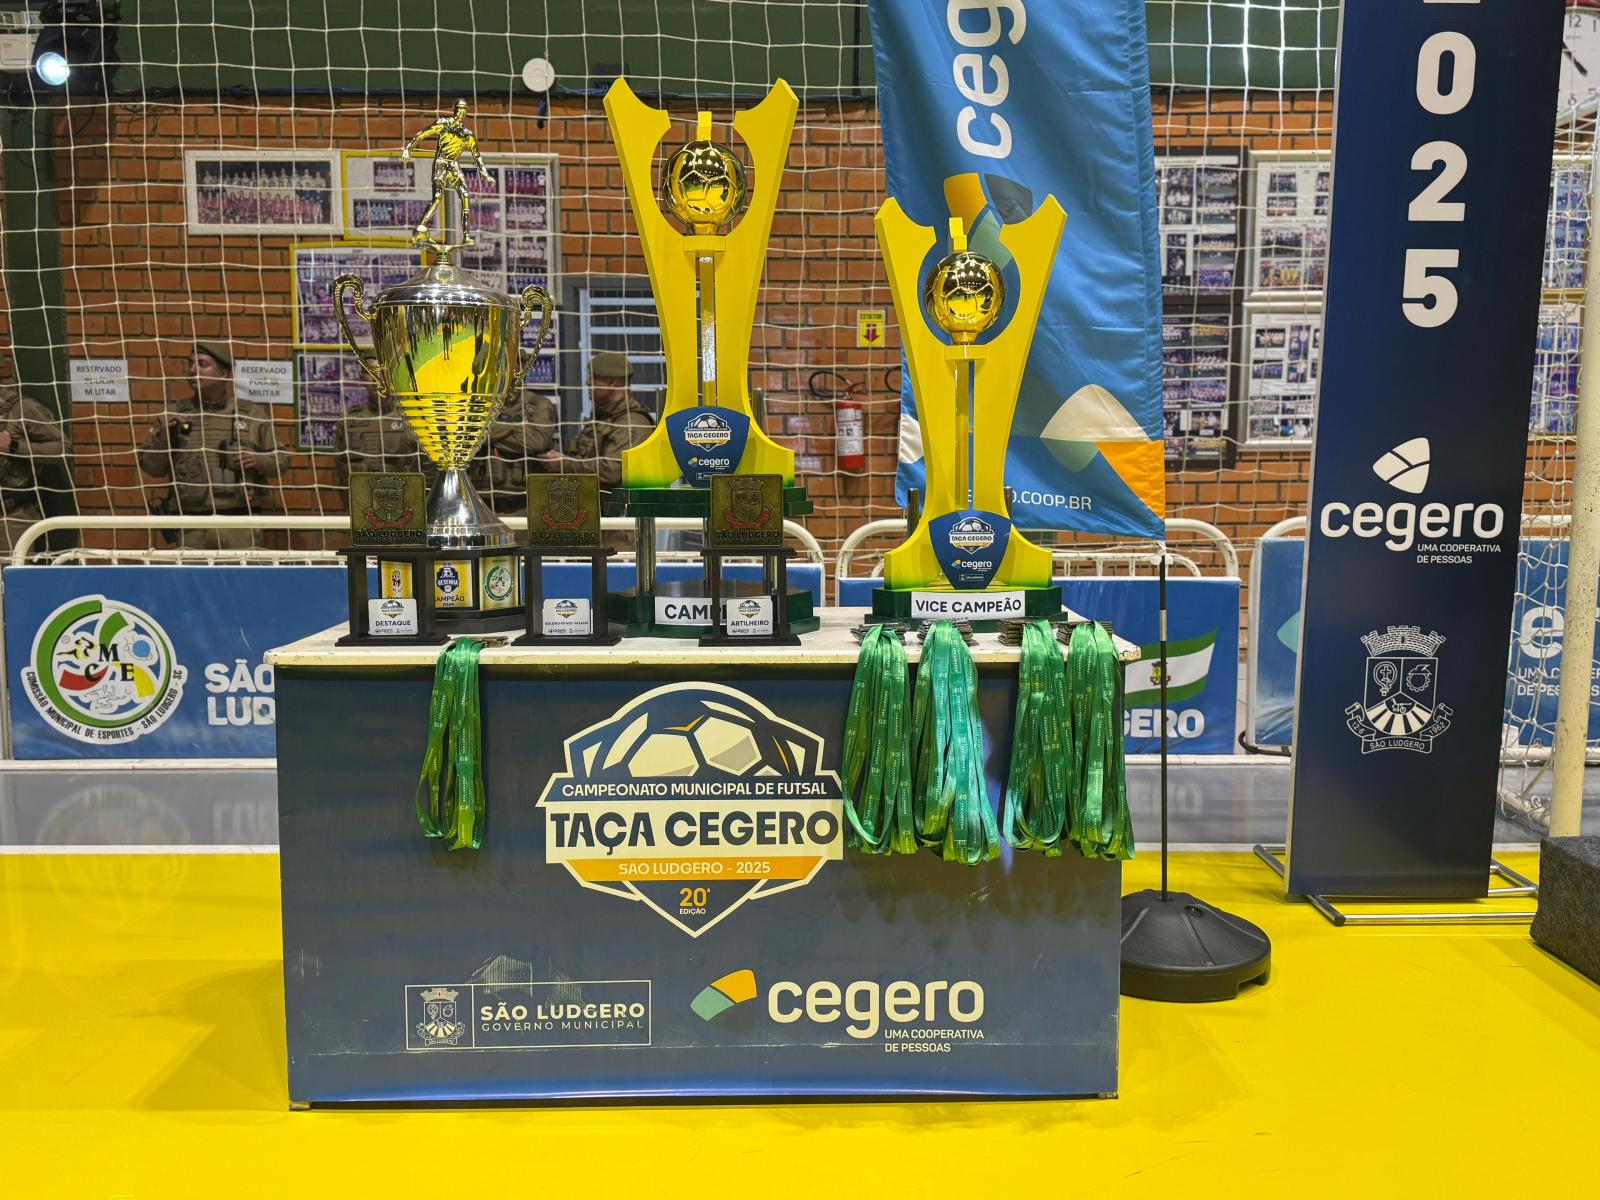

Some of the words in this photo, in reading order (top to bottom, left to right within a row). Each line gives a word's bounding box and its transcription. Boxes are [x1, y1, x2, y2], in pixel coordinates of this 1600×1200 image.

[1402, 0, 1482, 328] 025
[76, 365, 122, 374] RESERVADO
[241, 366, 287, 375] RESERVADO
[84, 388, 117, 397] MLITAR
[248, 389, 281, 398] MILITAR
[698, 458, 730, 468] cegero
[1320, 502, 1504, 552] cegero
[1417, 543, 1439, 552] UMA
[1439, 543, 1501, 553] COOPERATIVA
[961, 560, 992, 570] cegero
[1416, 555, 1429, 564] DE
[1430, 555, 1473, 564] PESSOAS
[435, 594, 465, 602] AMPEÃO
[915, 600, 948, 613] VICE
[951, 597, 1022, 613] CAMPEÃO
[98, 643, 119, 662] M
[204, 658, 275, 693] SÃO
[26, 671, 49, 708] COMISSÃO
[45, 707, 81, 735] MUNICIPAL
[84, 727, 95, 738] DE
[98, 726, 134, 740] ESPORTES
[141, 713, 157, 729] SÃO
[154, 688, 178, 718] LUDGERO
[173, 669, 182, 680] SC
[1428, 721, 1446, 736] 1962
[1369, 739, 1387, 750] SÃO
[1388, 738, 1426, 750] LUDGERO
[562, 783, 667, 797] CAMPEONATO
[671, 783, 753, 796] MUNICIPAL
[757, 783, 775, 795] DE
[777, 782, 827, 795] FUTSAL
[550, 812, 656, 856] TAÇA
[664, 810, 839, 847] CEGERO
[618, 861, 650, 875] SÃO
[653, 861, 724, 875] LUDGERO
[736, 861, 771, 874] 2025
[679, 907, 707, 916] EDIÇÃO
[480, 1002, 528, 1021] SÃO
[537, 1002, 645, 1020] LUDGERO
[768, 980, 985, 1039] cegero
[481, 1022, 554, 1032] GOVERNO
[561, 1020, 644, 1031] MUNICIPAL
[885, 1029, 909, 1039] UMA
[911, 1029, 984, 1039] COOPERATIVA
[885, 1043, 899, 1052] DE
[902, 1043, 951, 1052] PESSOAS
